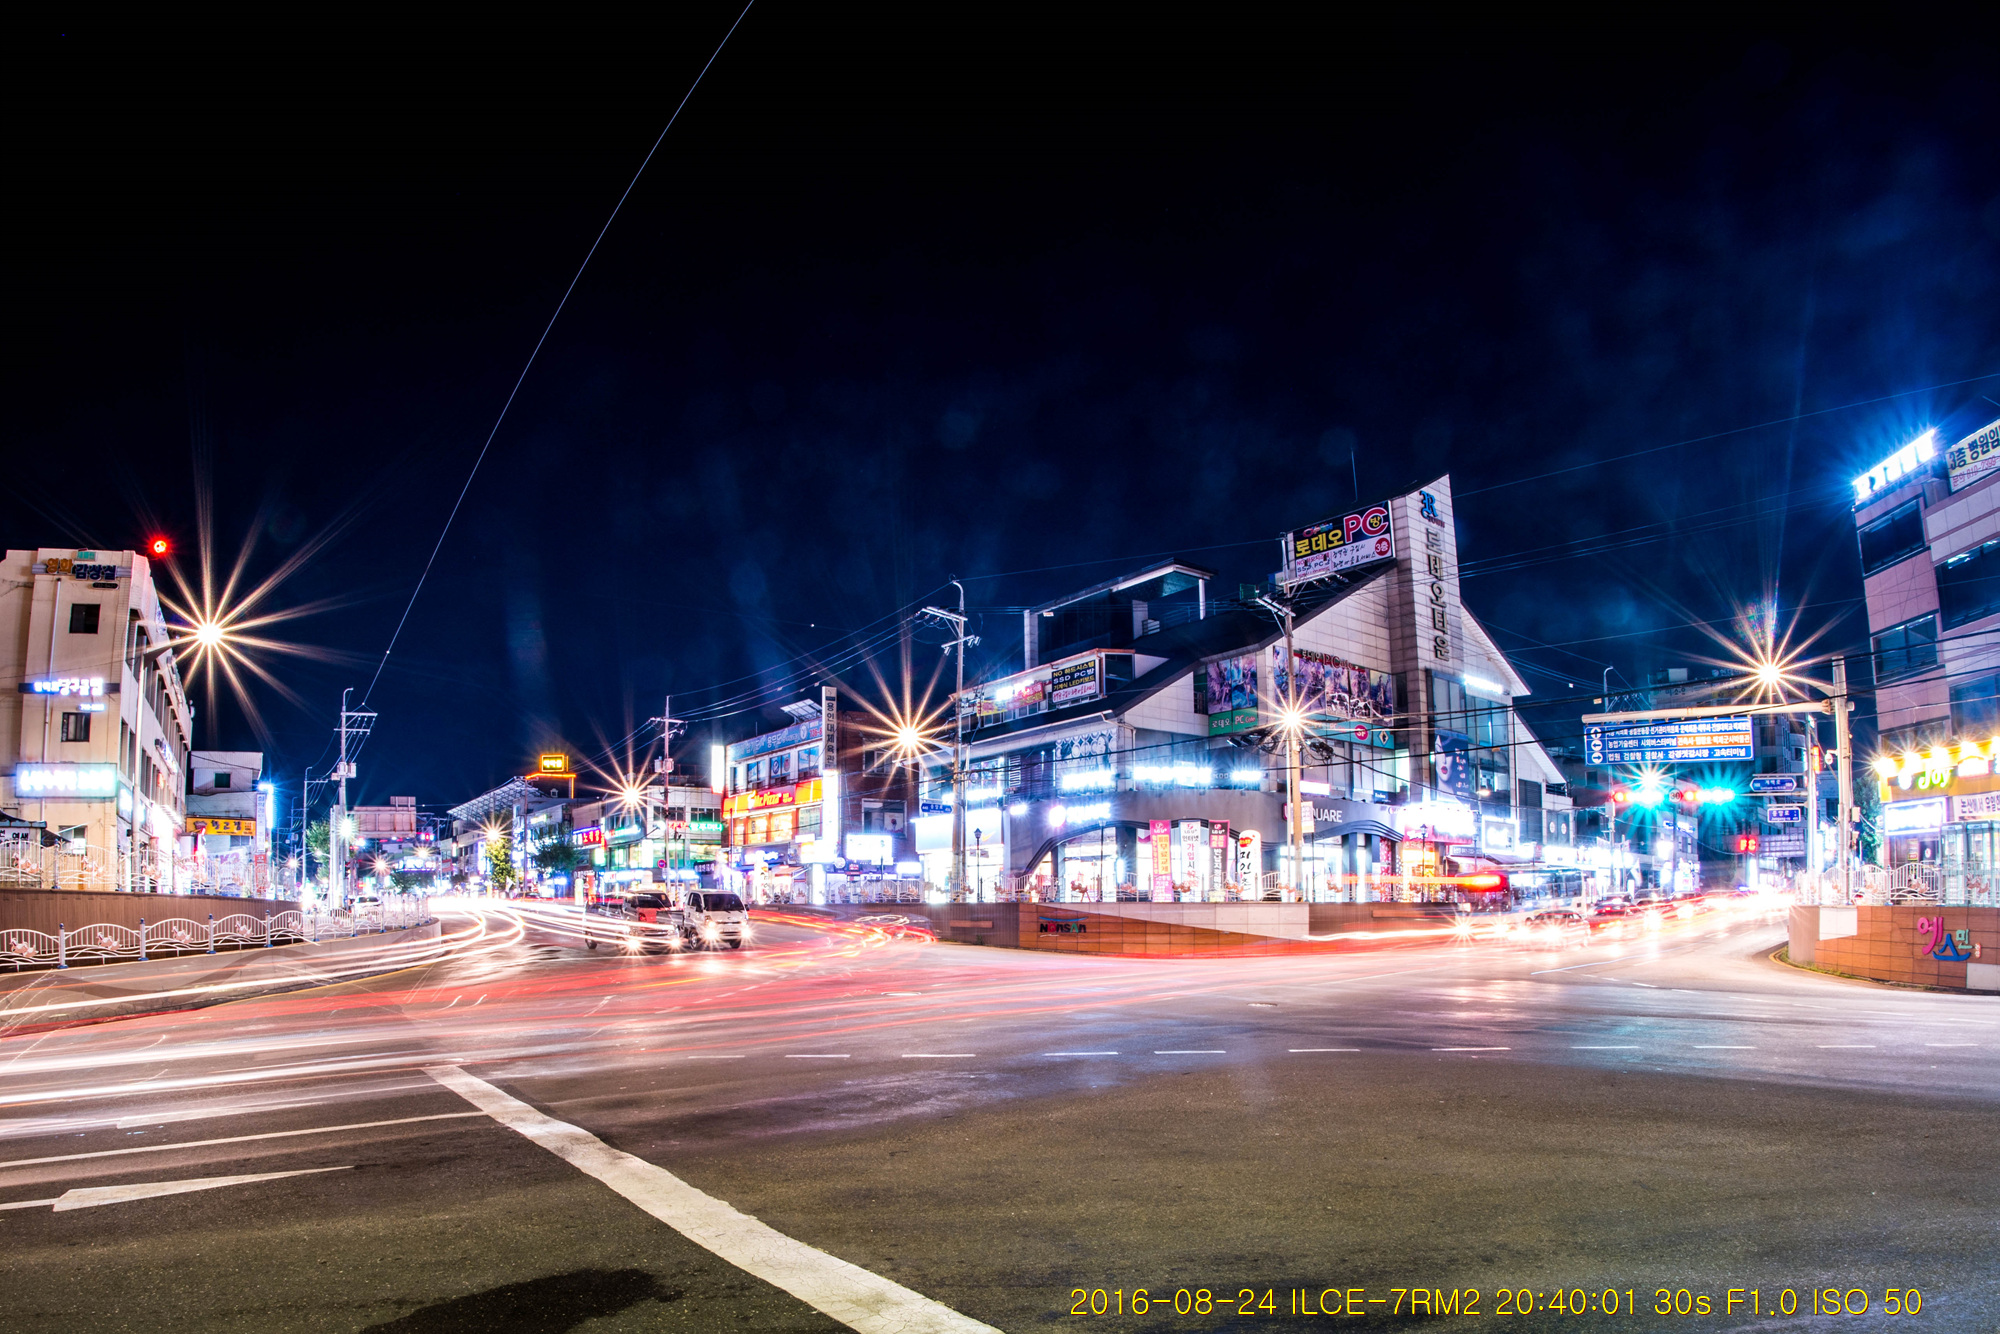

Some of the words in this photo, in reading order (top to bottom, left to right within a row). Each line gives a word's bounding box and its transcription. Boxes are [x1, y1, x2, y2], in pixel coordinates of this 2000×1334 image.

[1296, 529, 1344, 557] 로데오
[75, 564, 116, 580] 감상실
[1053, 675, 1071, 684] SSD
[1212, 718, 1230, 728] 로데오
[1235, 714, 1245, 725] PC
[1641, 737, 1677, 747] 시외버스터미널
[1713, 747, 1746, 757] 고속터미널
[1960, 798, 1984, 814] 논산에서
